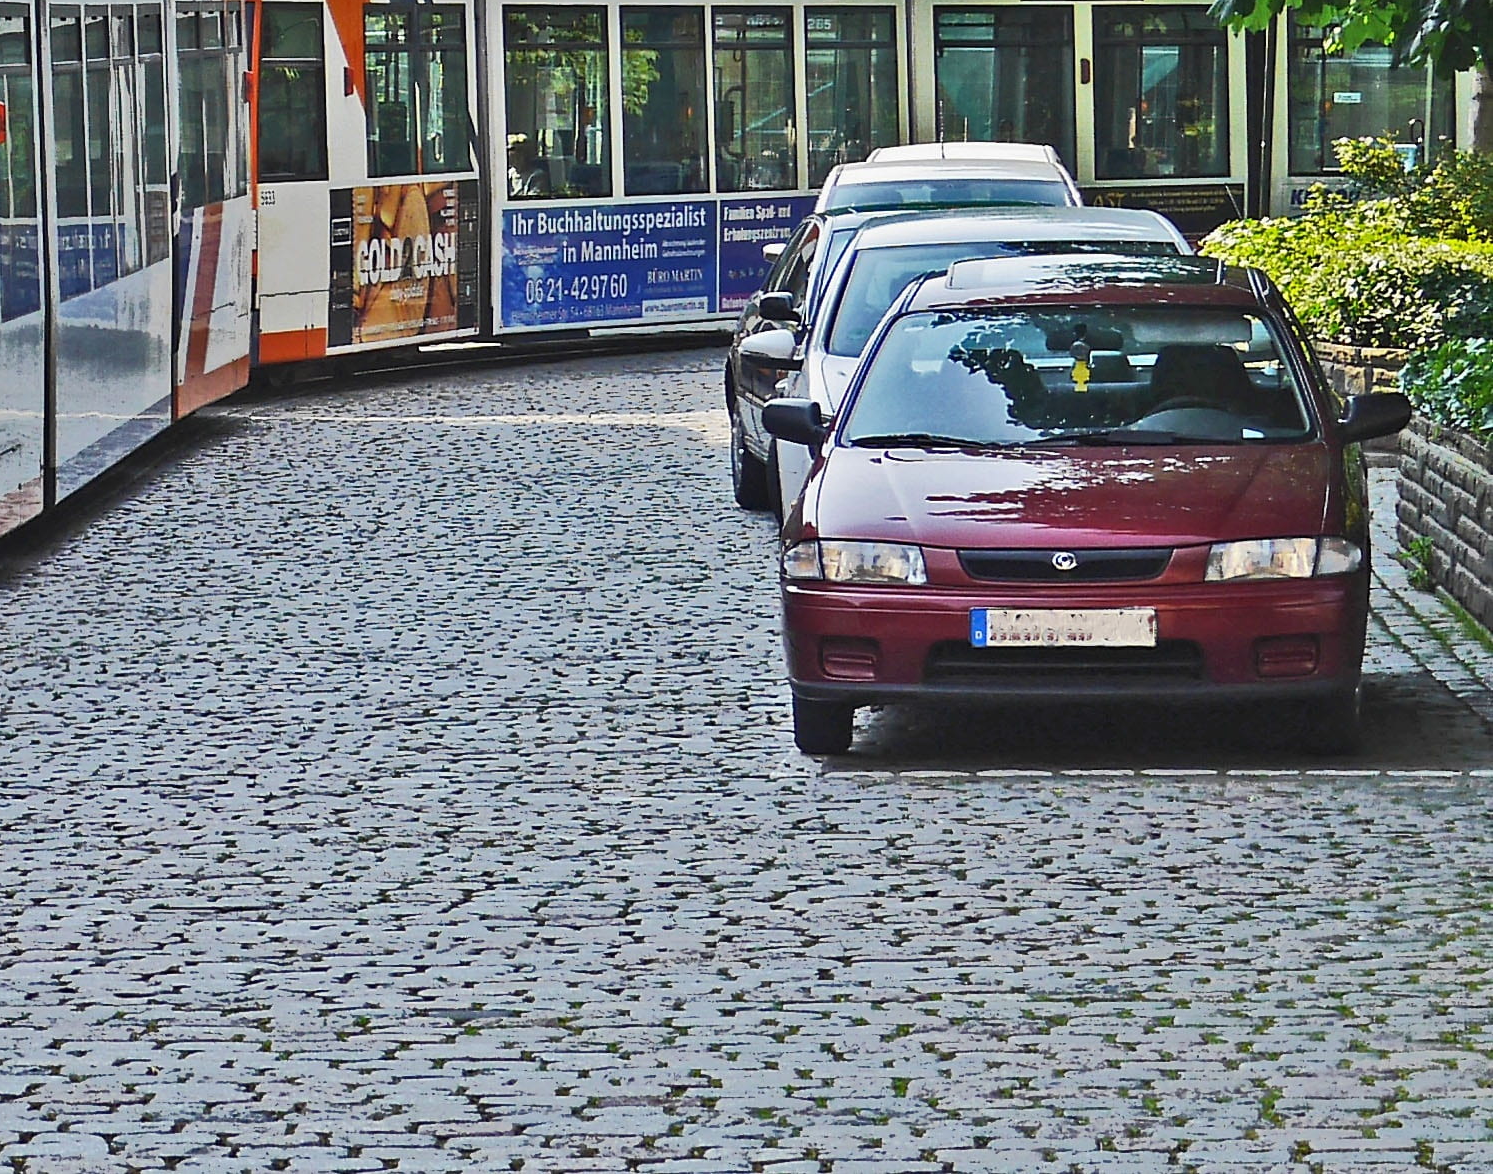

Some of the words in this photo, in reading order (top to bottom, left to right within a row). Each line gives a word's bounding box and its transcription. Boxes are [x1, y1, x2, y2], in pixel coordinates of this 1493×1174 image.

[512, 212, 534, 236] Ihr
[537, 205, 707, 237] Buchhaltungsspezialist
[562, 240, 577, 263] in
[580, 237, 658, 263] Mannheim
